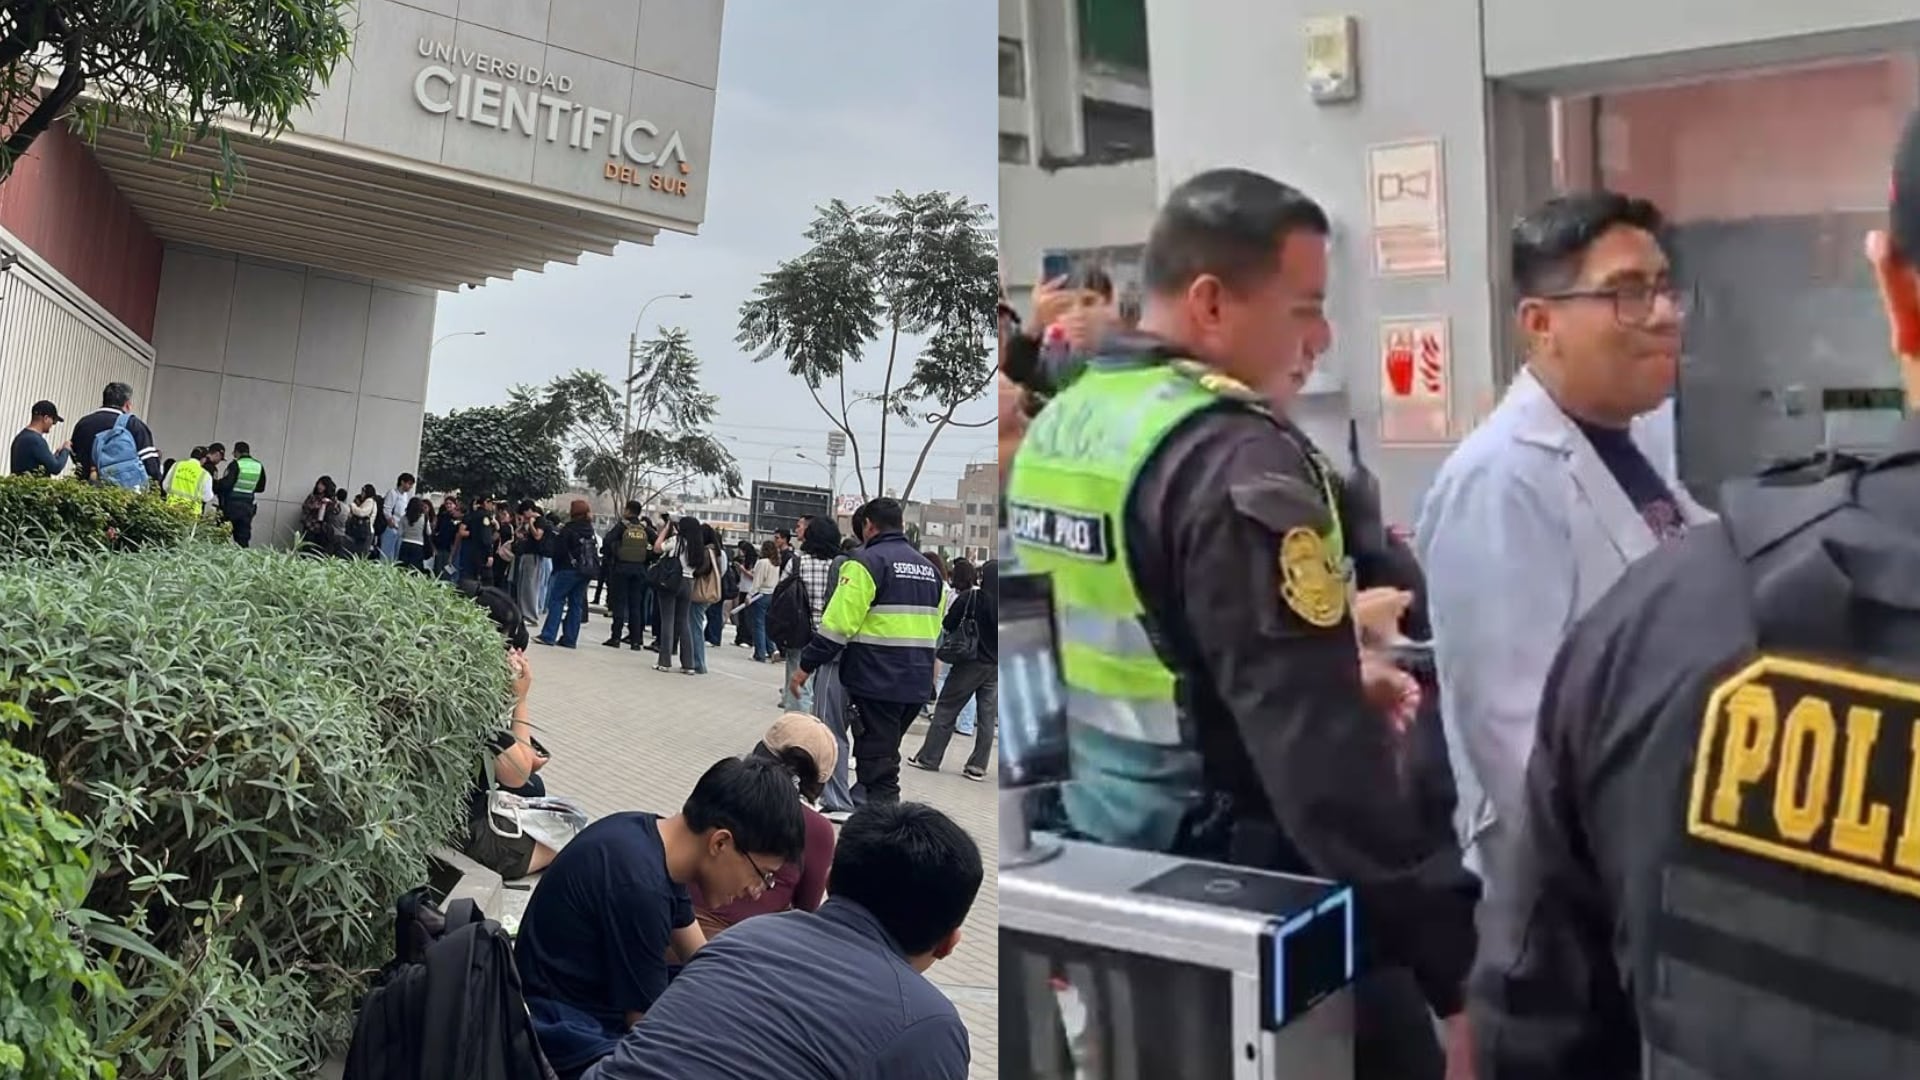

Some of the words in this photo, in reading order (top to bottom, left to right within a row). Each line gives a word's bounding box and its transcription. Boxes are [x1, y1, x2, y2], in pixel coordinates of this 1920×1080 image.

[417, 37, 574, 93] UNIVERSIDAD
[604, 162, 641, 188] DEL
[649, 174, 689, 197] SUR
[893, 562, 935, 577] SERENAZGO
